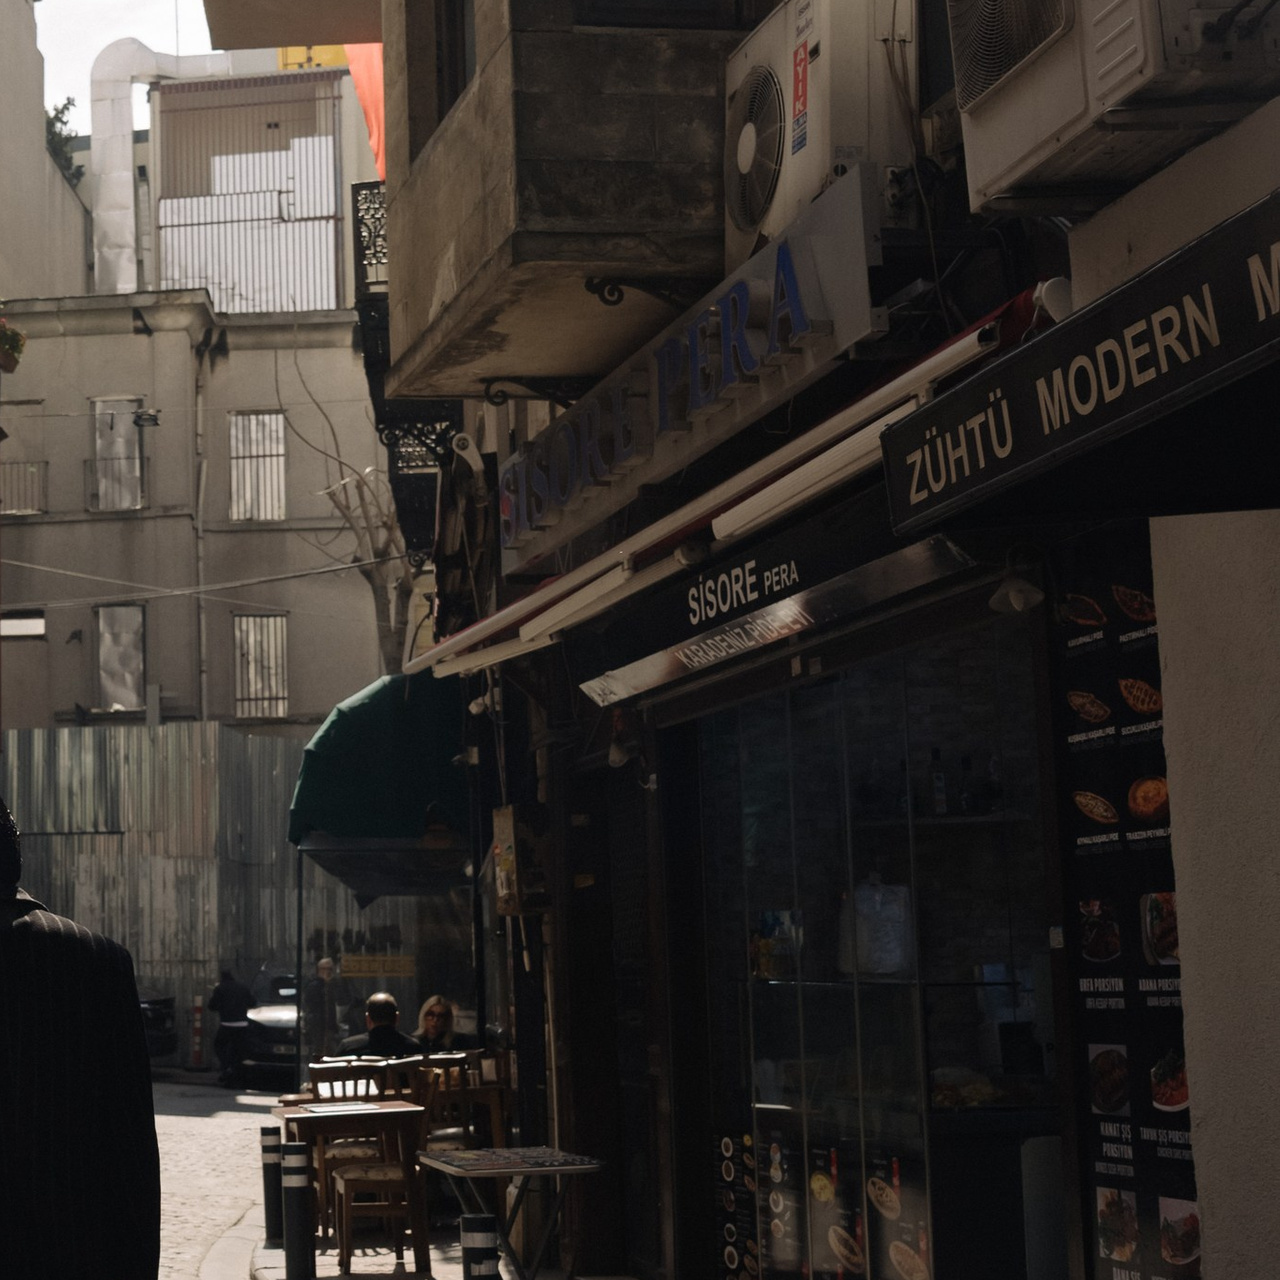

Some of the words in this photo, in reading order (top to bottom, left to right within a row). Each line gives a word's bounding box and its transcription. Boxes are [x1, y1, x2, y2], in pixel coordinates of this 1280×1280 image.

[795, 46, 806, 116] AYIK
[653, 238, 812, 433] PERA
[905, 387, 1014, 507] ZÜHTÜ
[1035, 283, 1220, 437] MODERN
[687, 558, 760, 626] SİSORE
[764, 559, 800, 595] PERA
[674, 626, 756, 669] KARADENİZ
[744, 613, 789, 643] PİDE
[1103, 1142, 1133, 1160] PORSİYON
